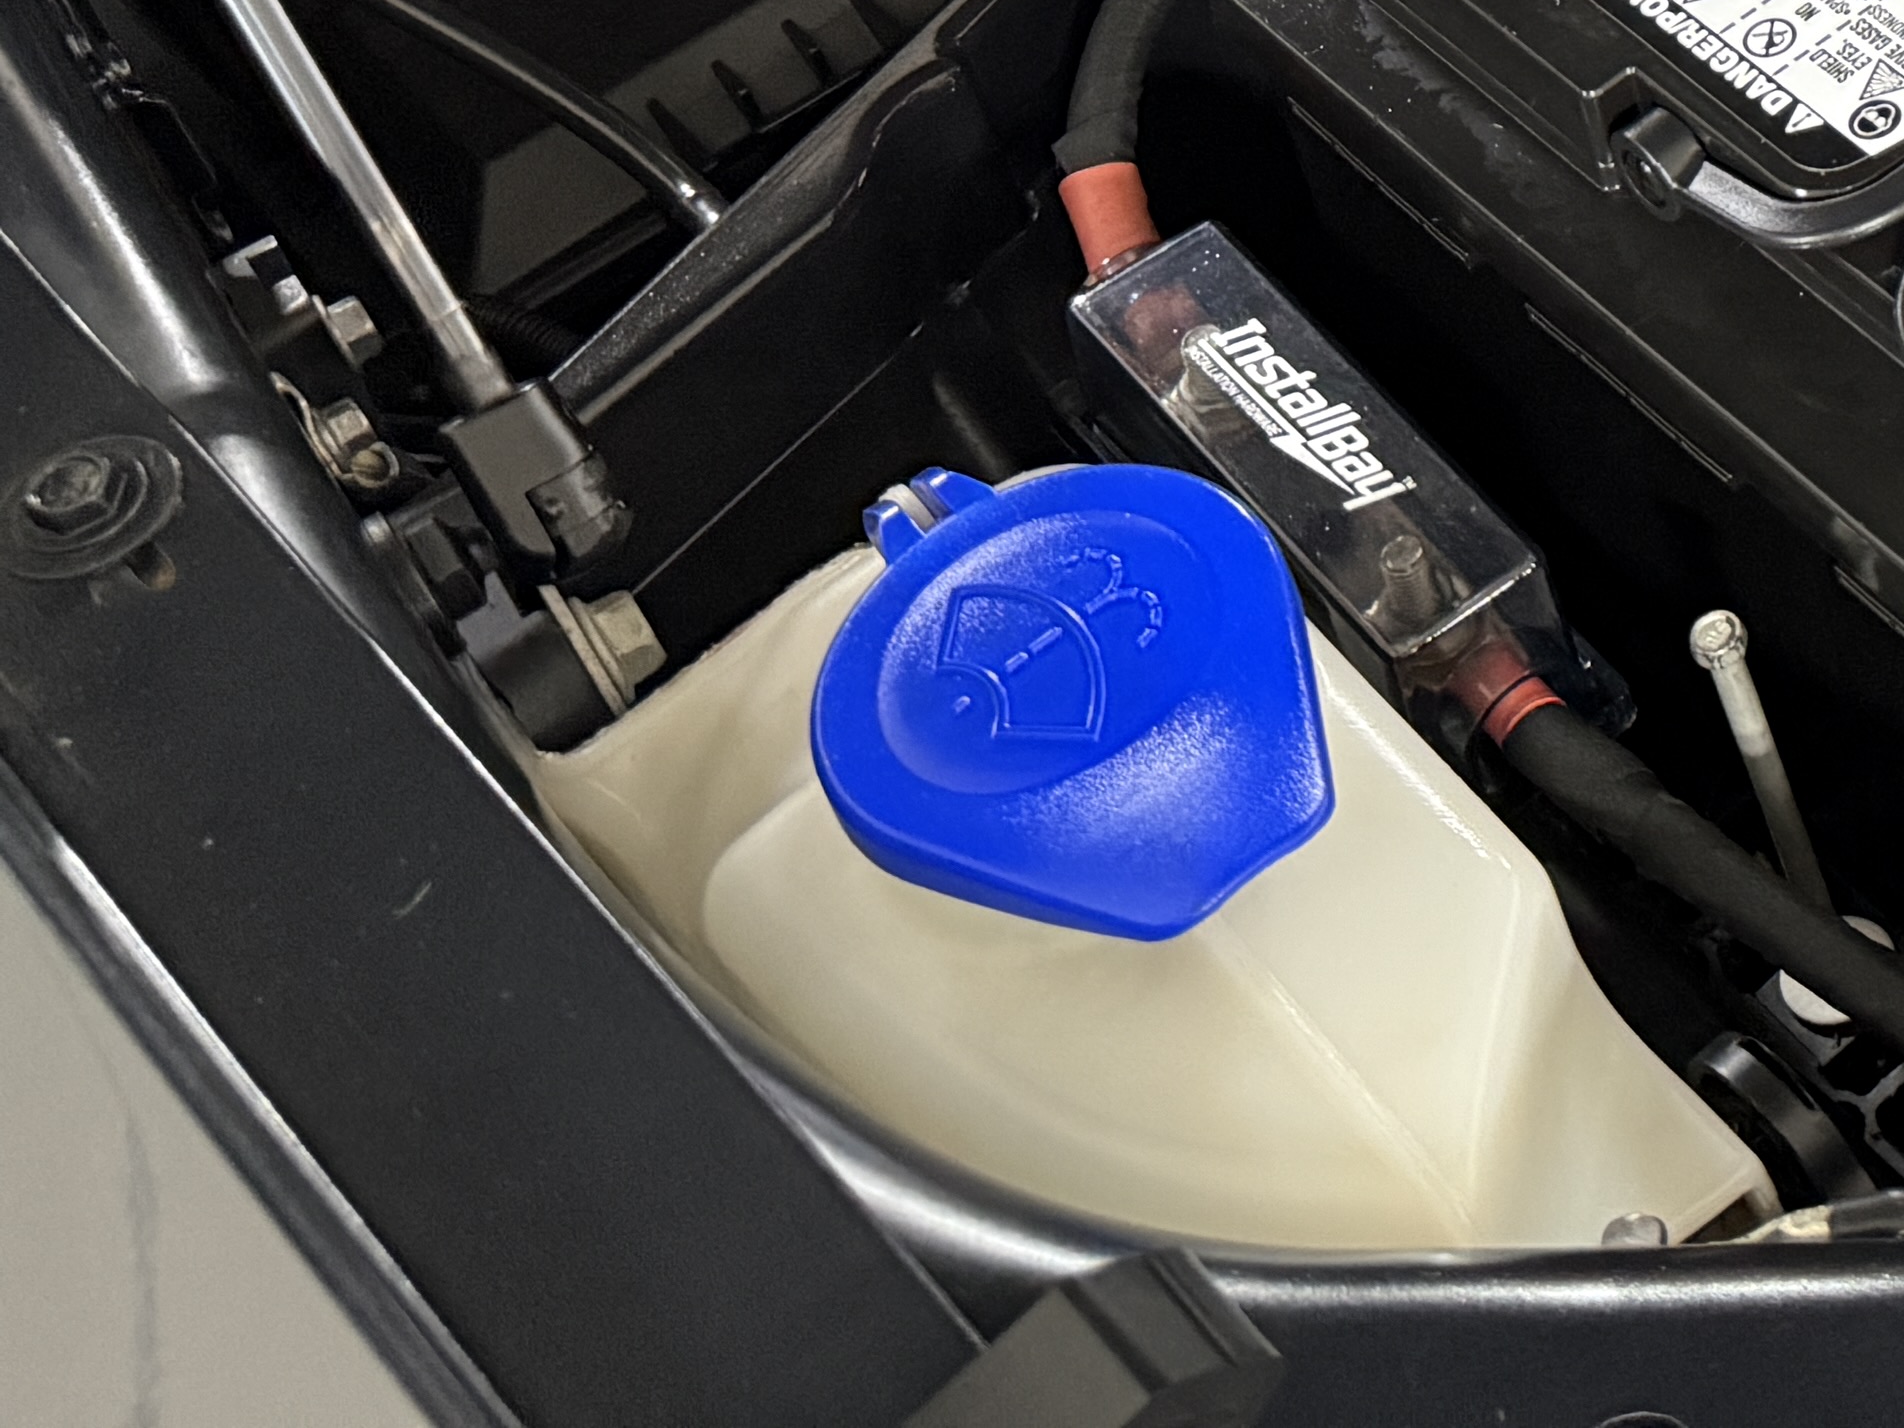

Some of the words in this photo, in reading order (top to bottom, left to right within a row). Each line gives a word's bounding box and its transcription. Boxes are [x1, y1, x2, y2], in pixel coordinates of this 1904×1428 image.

[1795, 2, 1821, 22] NO
[1849, 18, 1893, 51] GASES
[1809, 48, 1856, 84] SHIELD
[1184, 342, 1241, 400] INSTALLATION
[1233, 392, 1286, 441] HARDWARE
[1212, 315, 1413, 510] InstallBay
